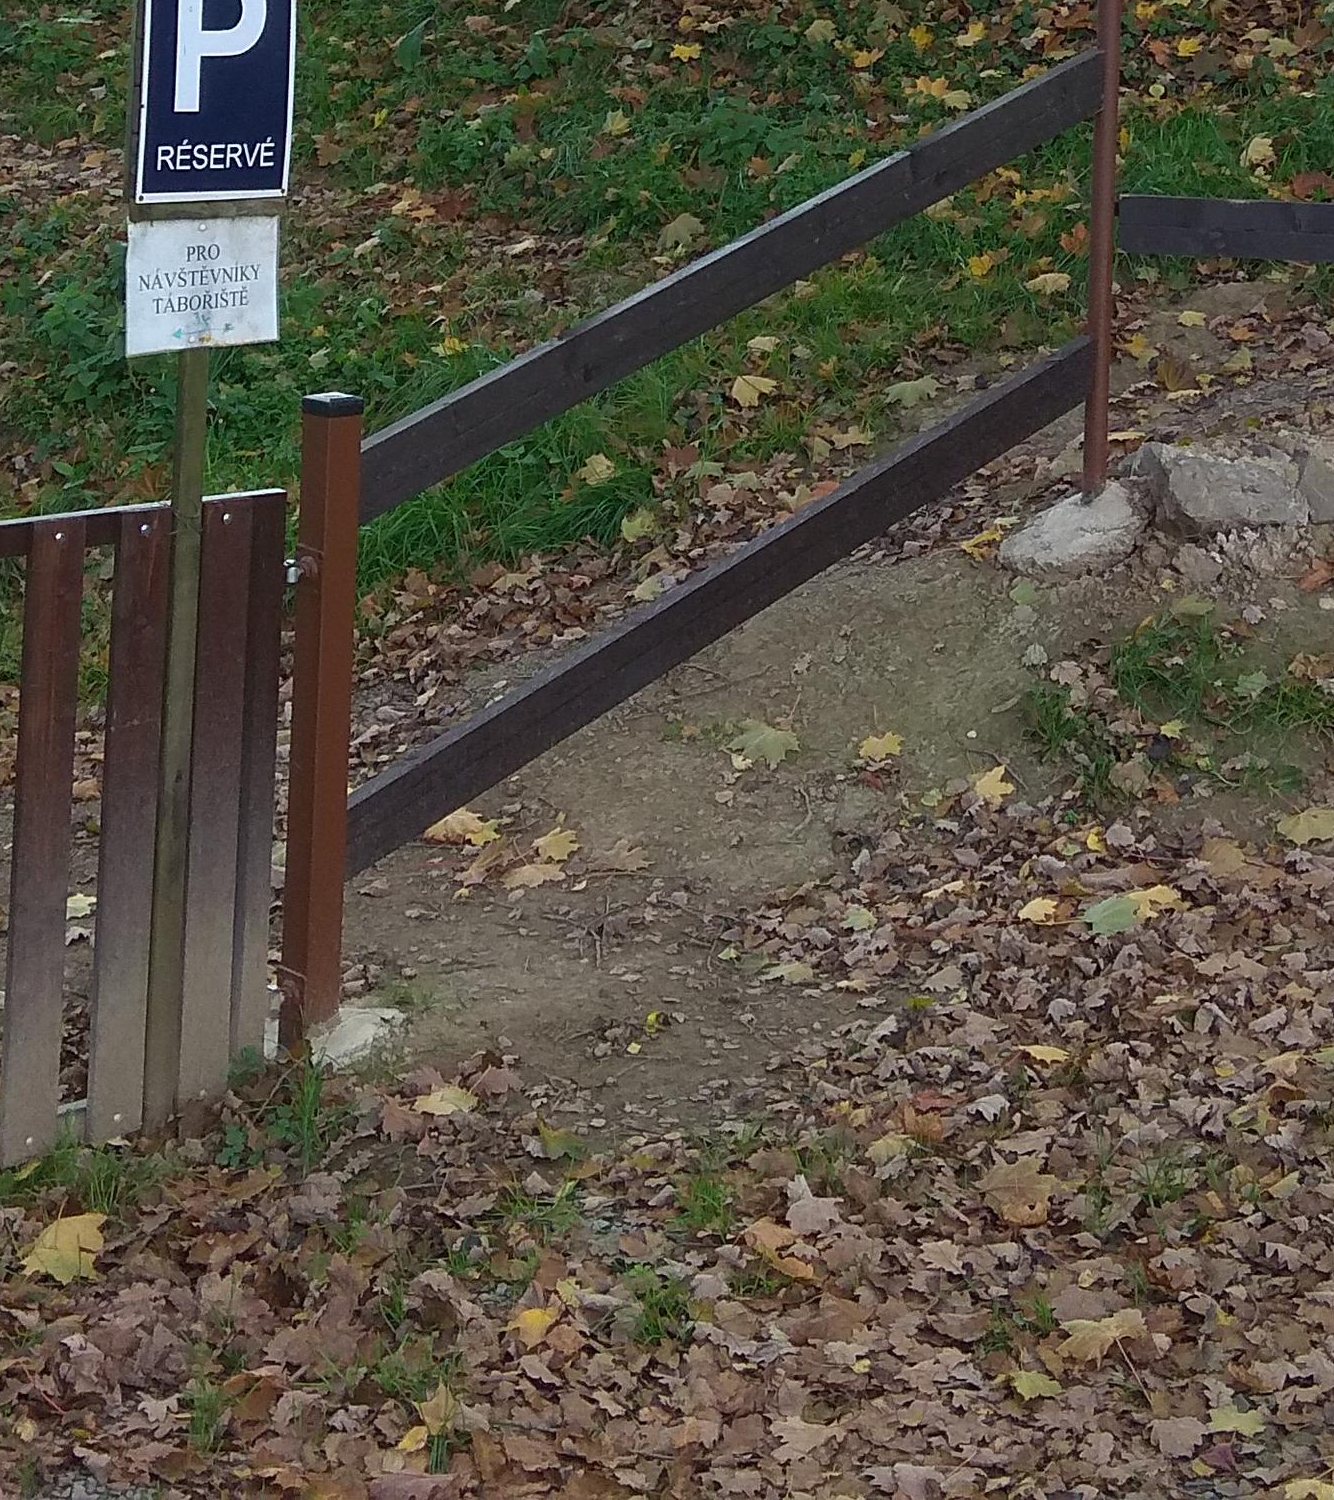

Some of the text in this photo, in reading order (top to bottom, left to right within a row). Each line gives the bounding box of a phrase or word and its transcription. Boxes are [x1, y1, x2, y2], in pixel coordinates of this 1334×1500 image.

[156, 137, 276, 171] RÉSERVÉ
[186, 243, 221, 263] PRO
[138, 261, 261, 292] NÁVŠTĚVNÍKY
[152, 286, 250, 315] TÁBOŘIŠTĚ
